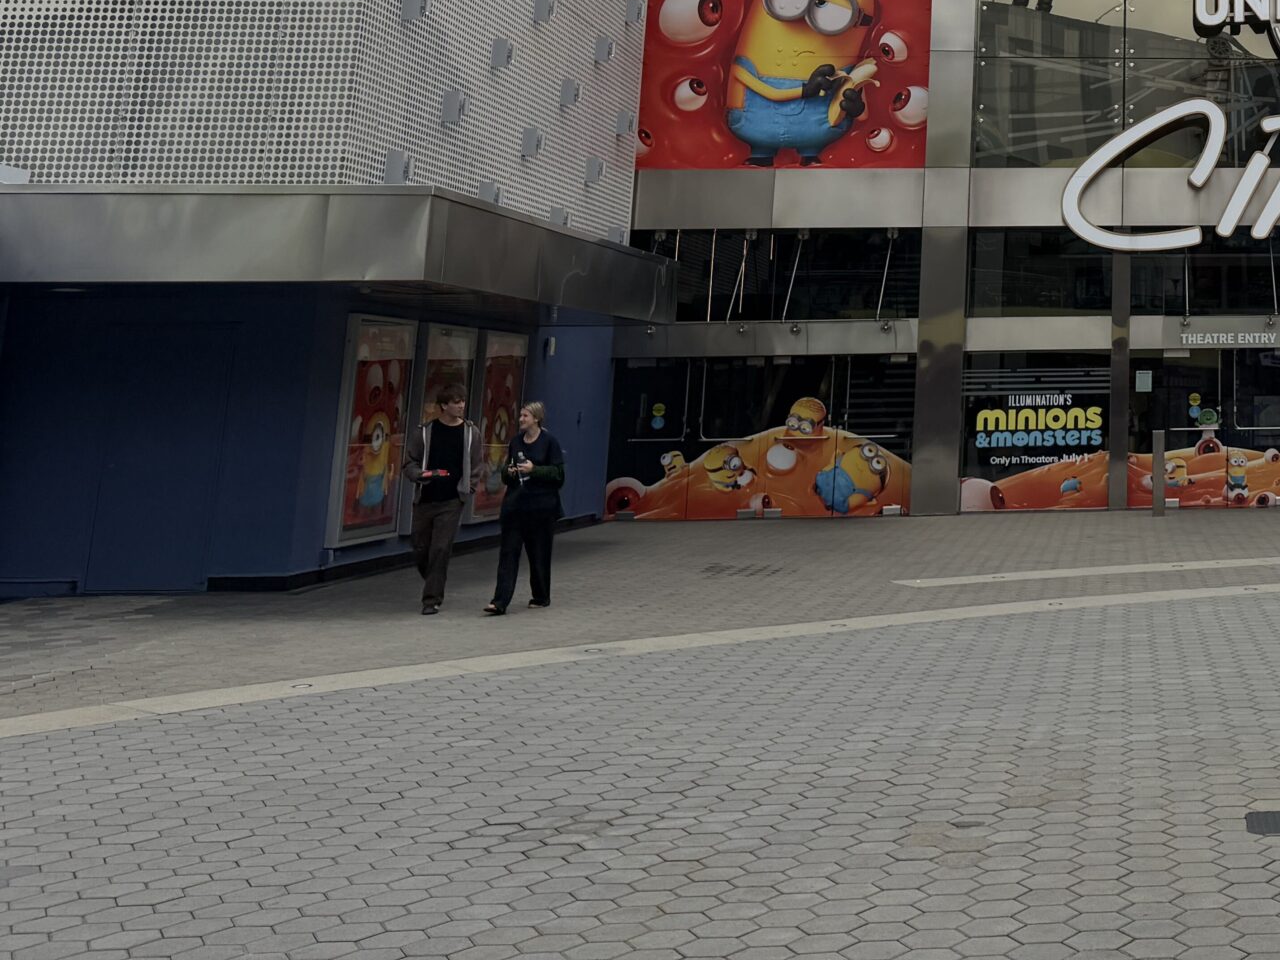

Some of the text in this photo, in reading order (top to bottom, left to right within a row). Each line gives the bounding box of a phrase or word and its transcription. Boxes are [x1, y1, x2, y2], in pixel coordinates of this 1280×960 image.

[1180, 333, 1277, 344] THEATRE ENTRY
[1008, 394, 1072, 407] ILLUMINATION'S
[976, 406, 1103, 431] minions
[990, 456, 1011, 467] Only
[1021, 455, 1059, 464] Theaters
[1060, 453, 1083, 465] July
[1084, 453, 1089, 462] 1
